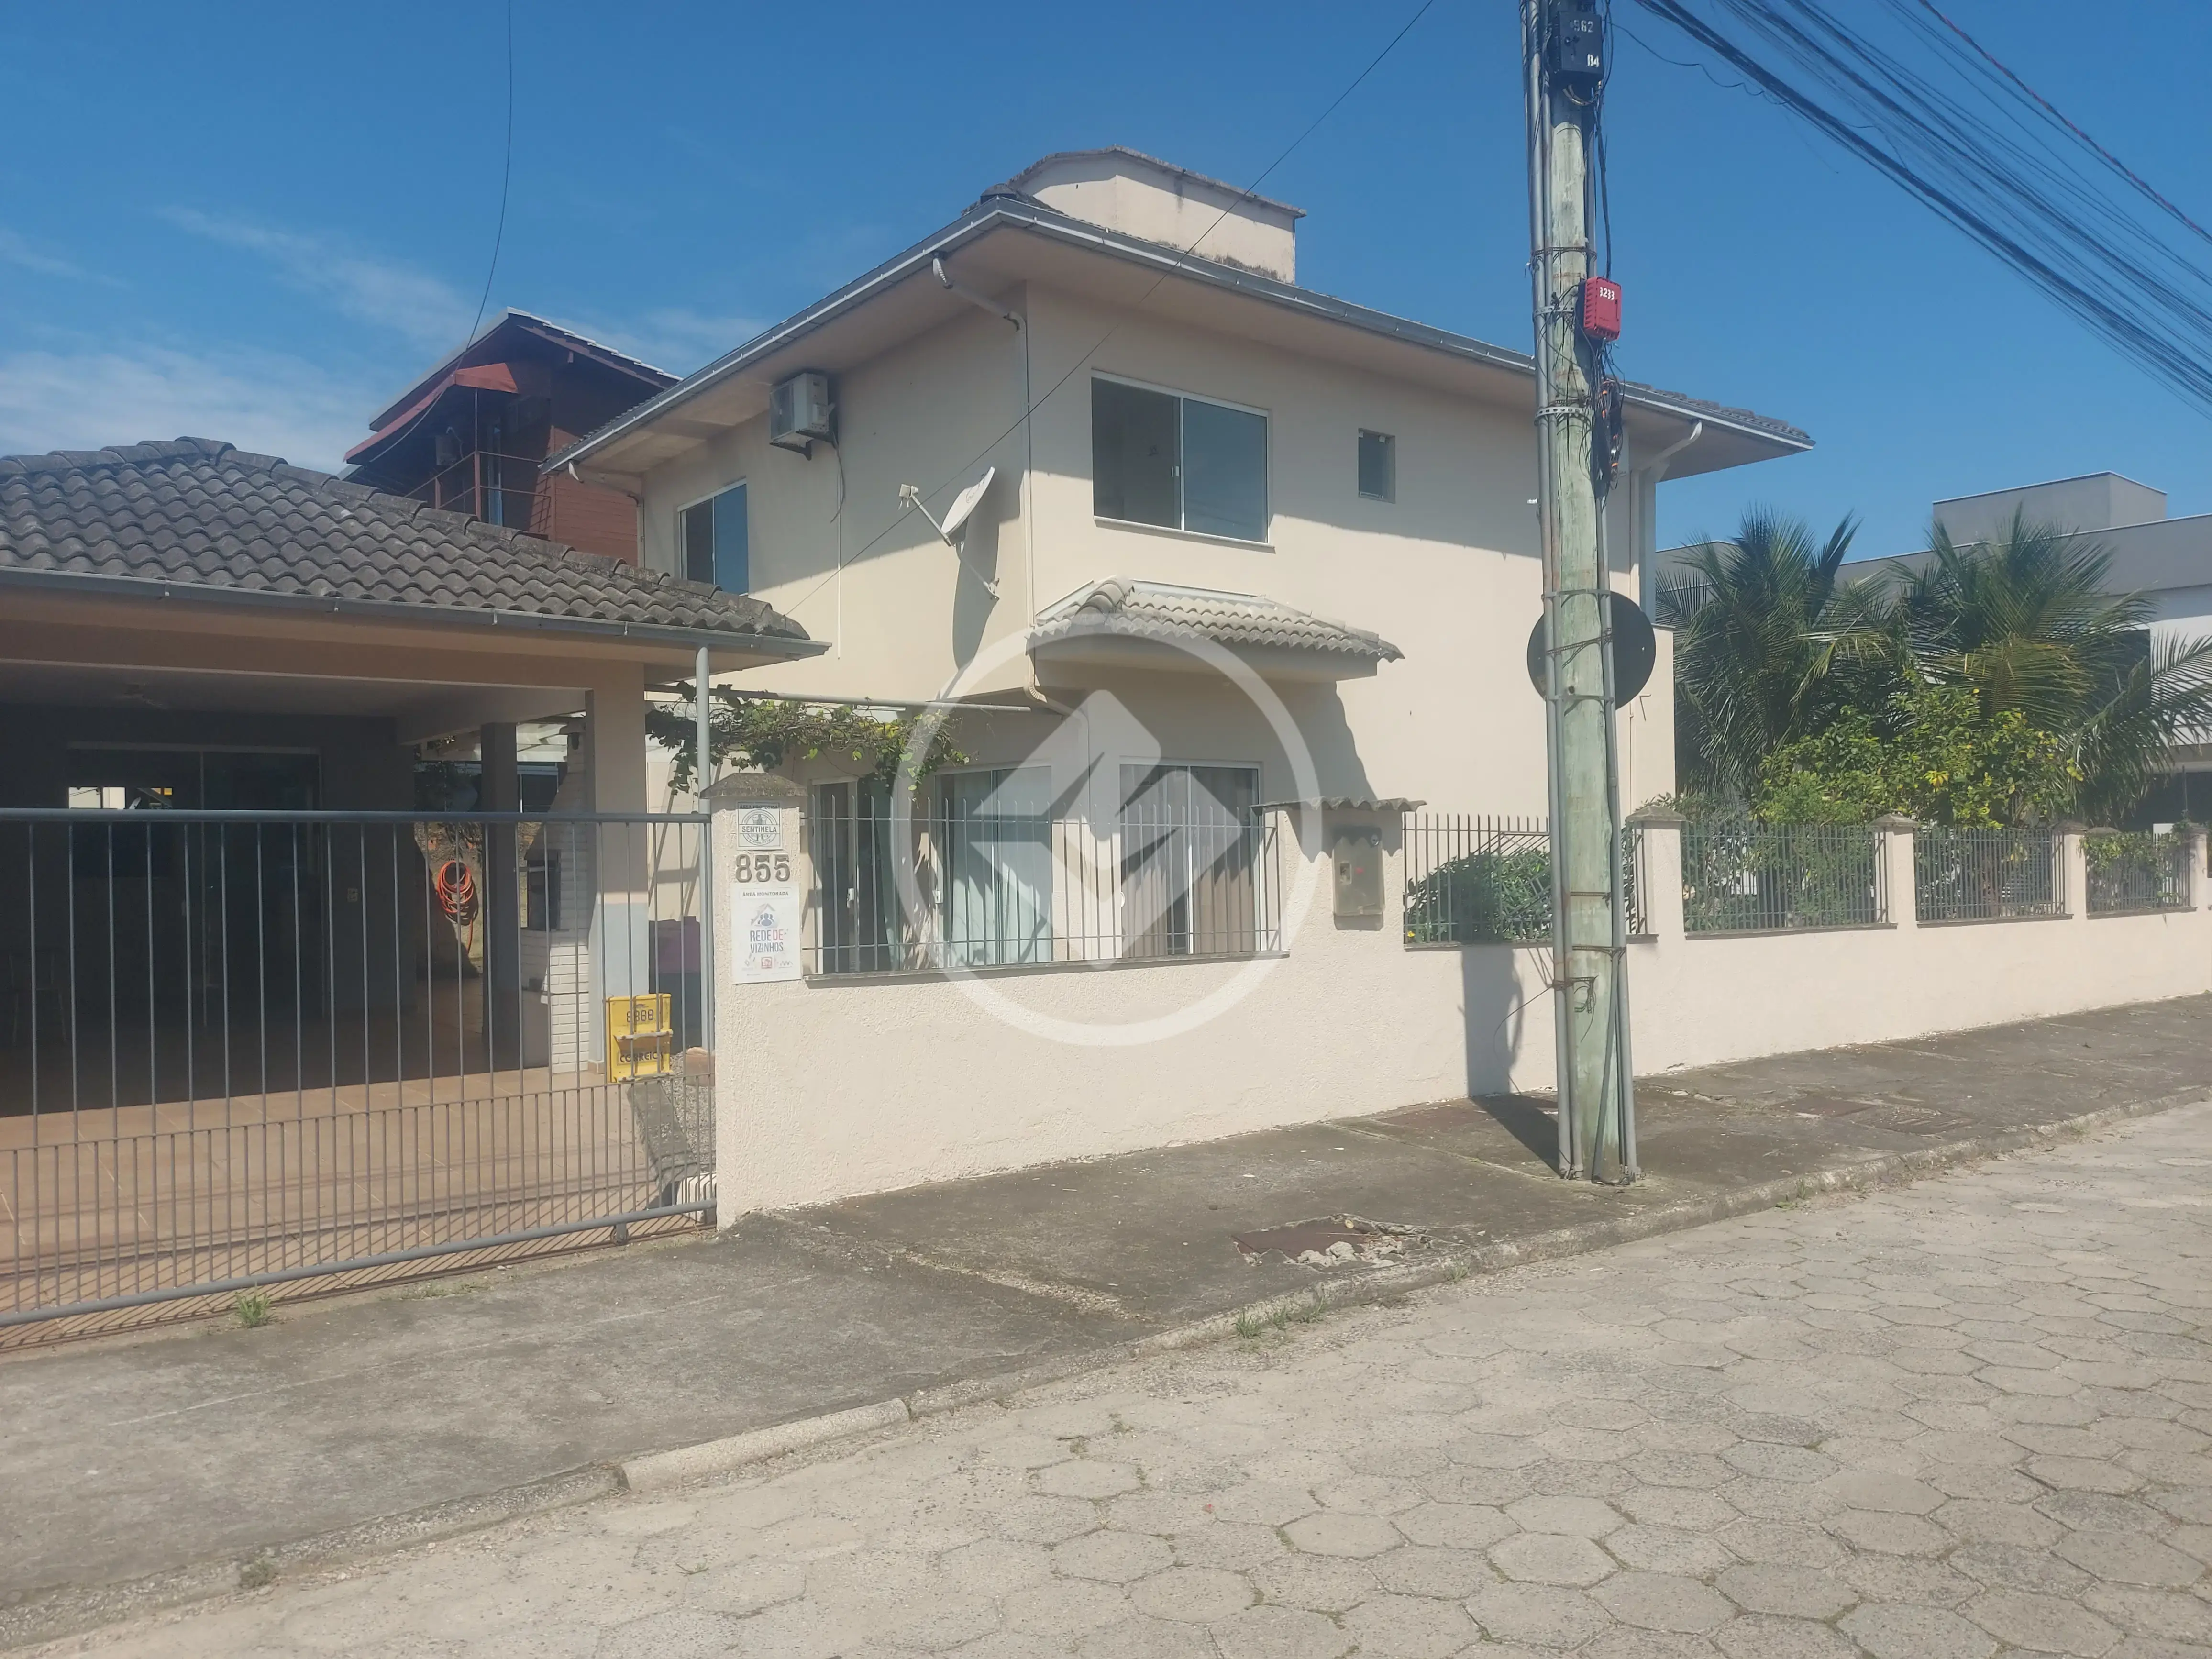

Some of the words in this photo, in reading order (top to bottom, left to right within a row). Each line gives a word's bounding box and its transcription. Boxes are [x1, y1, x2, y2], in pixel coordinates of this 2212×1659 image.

[1600, 287, 1615, 300] 3233
[735, 854, 790, 883] 855
[750, 930, 772, 942] REDE
[773, 929, 784, 940] DE
[750, 942, 784, 953] VIZINHOS
